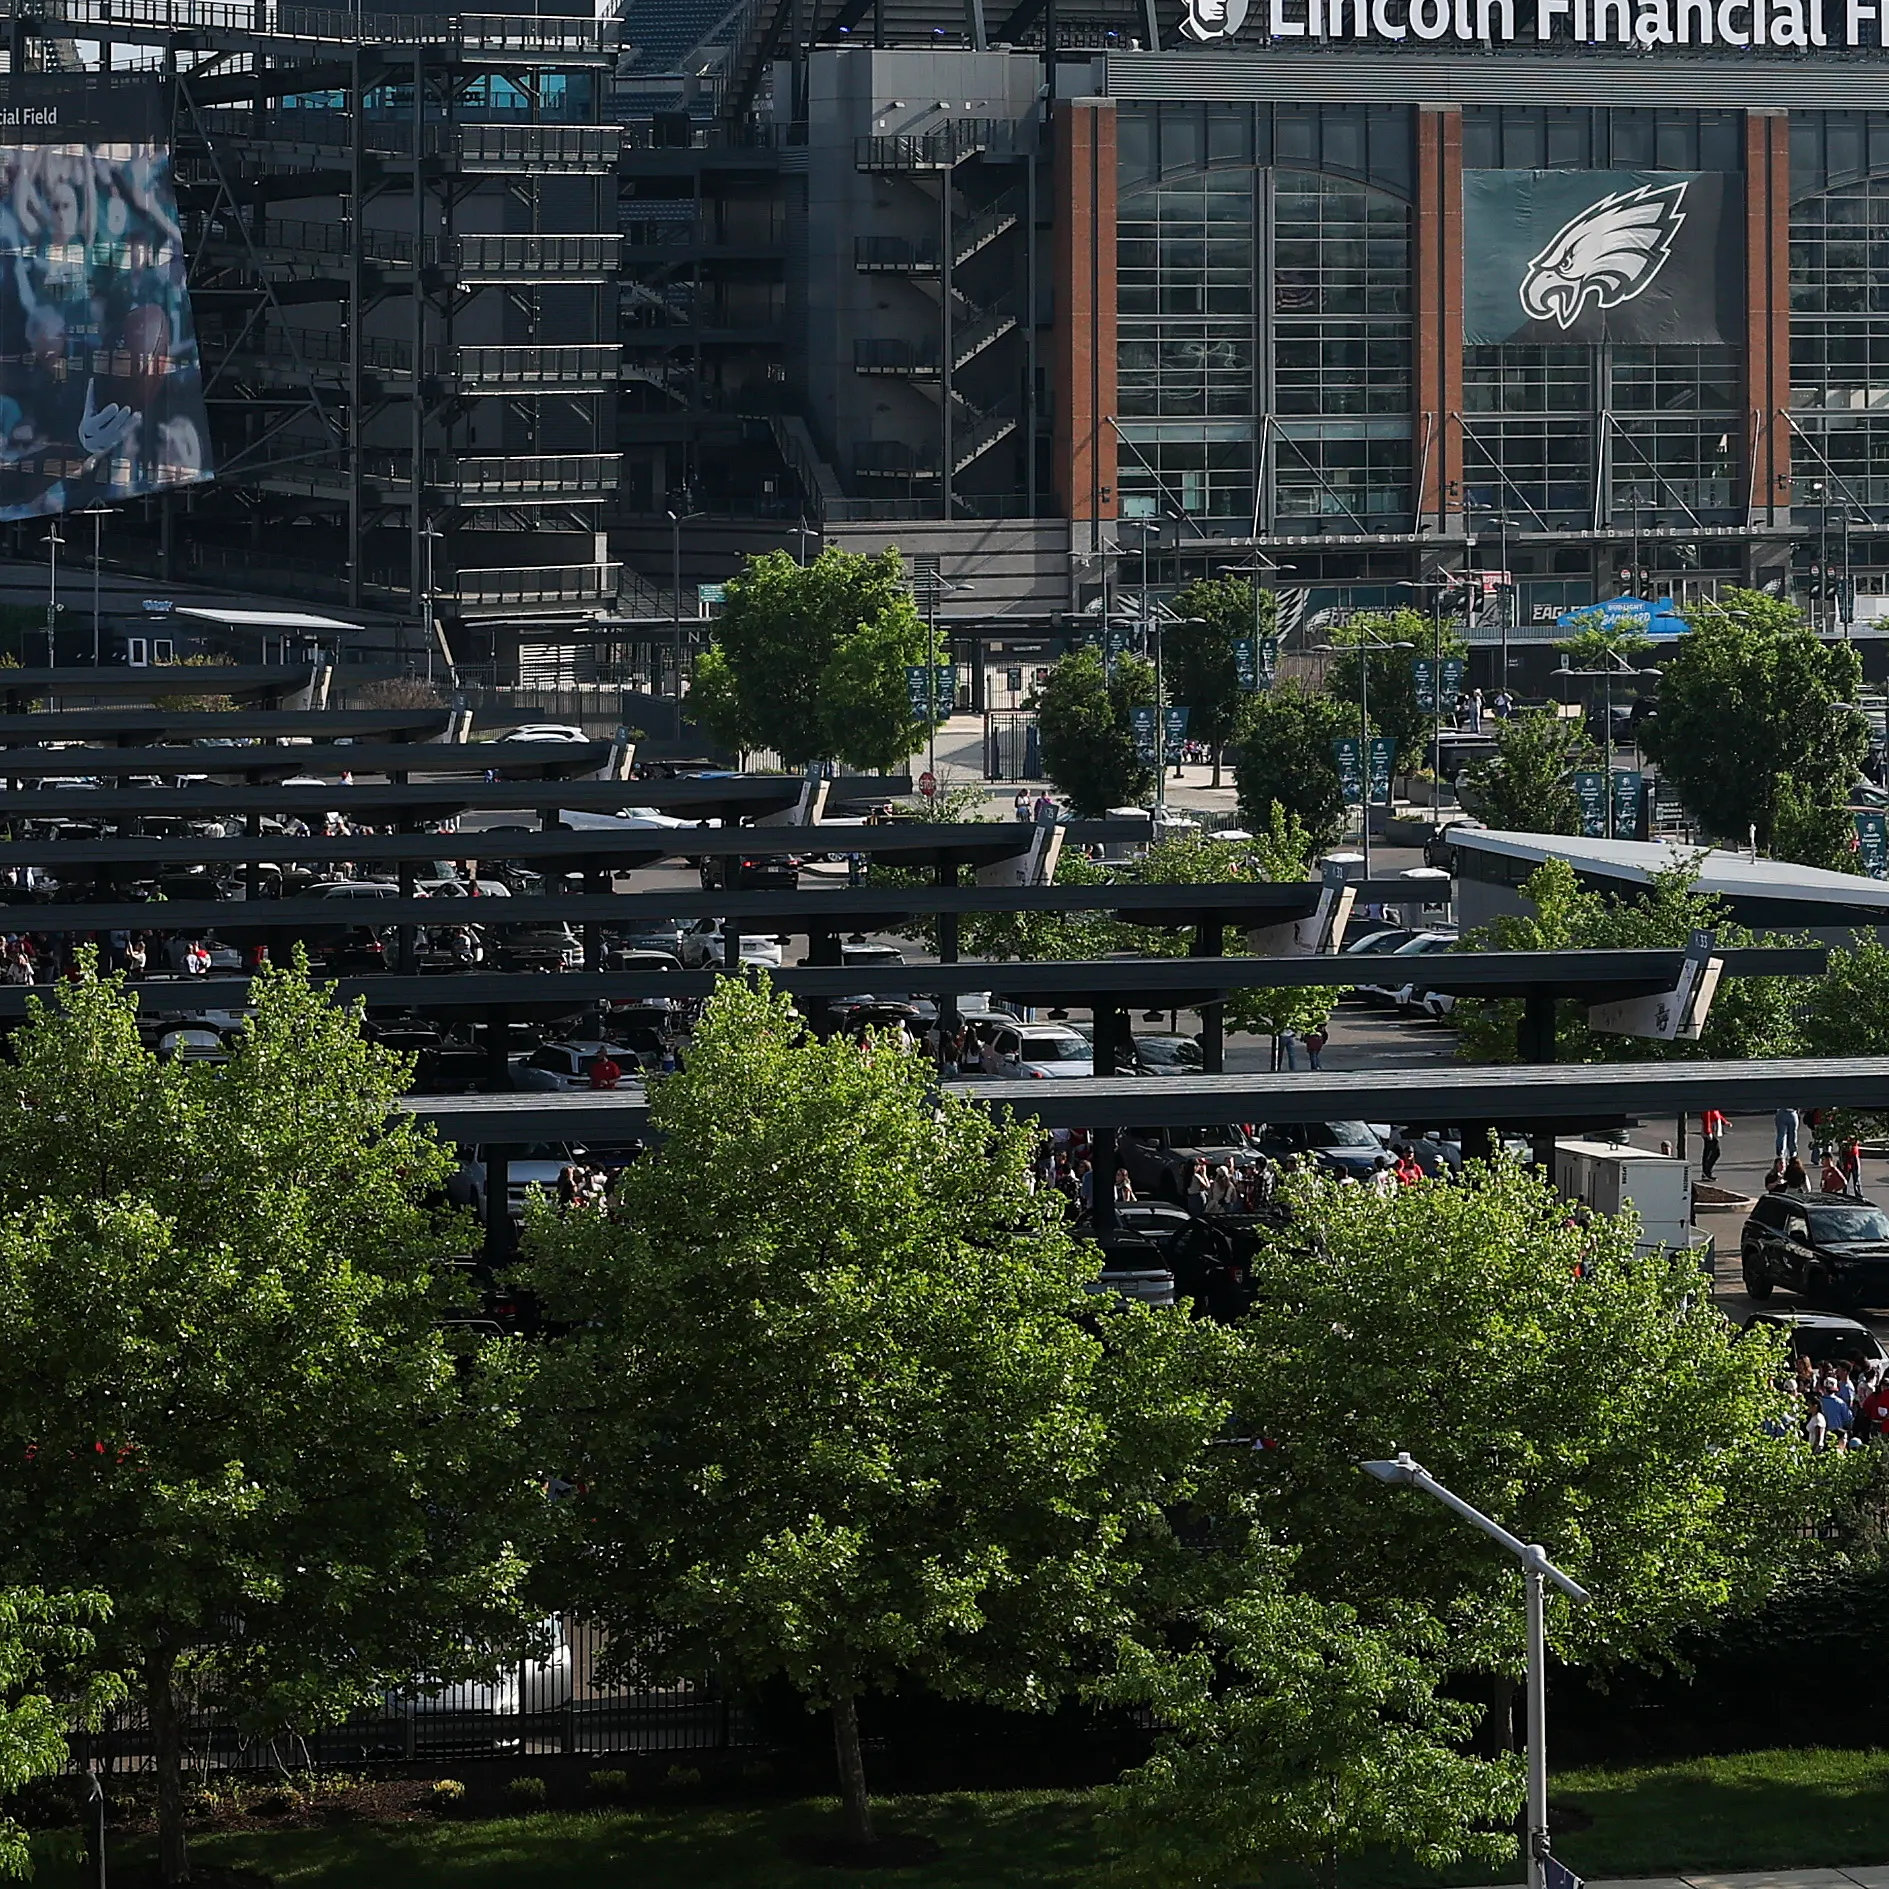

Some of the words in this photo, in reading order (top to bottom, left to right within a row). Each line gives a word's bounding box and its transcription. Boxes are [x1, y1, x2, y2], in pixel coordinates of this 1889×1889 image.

[23, 106, 57, 125] Field
[1581, 530, 1616, 539] RED
[1692, 526, 1759, 536] SUITES
[1230, 536, 1308, 546] EAGLES
[1325, 535, 1362, 544] PRO
[1378, 533, 1431, 543] SHOP
